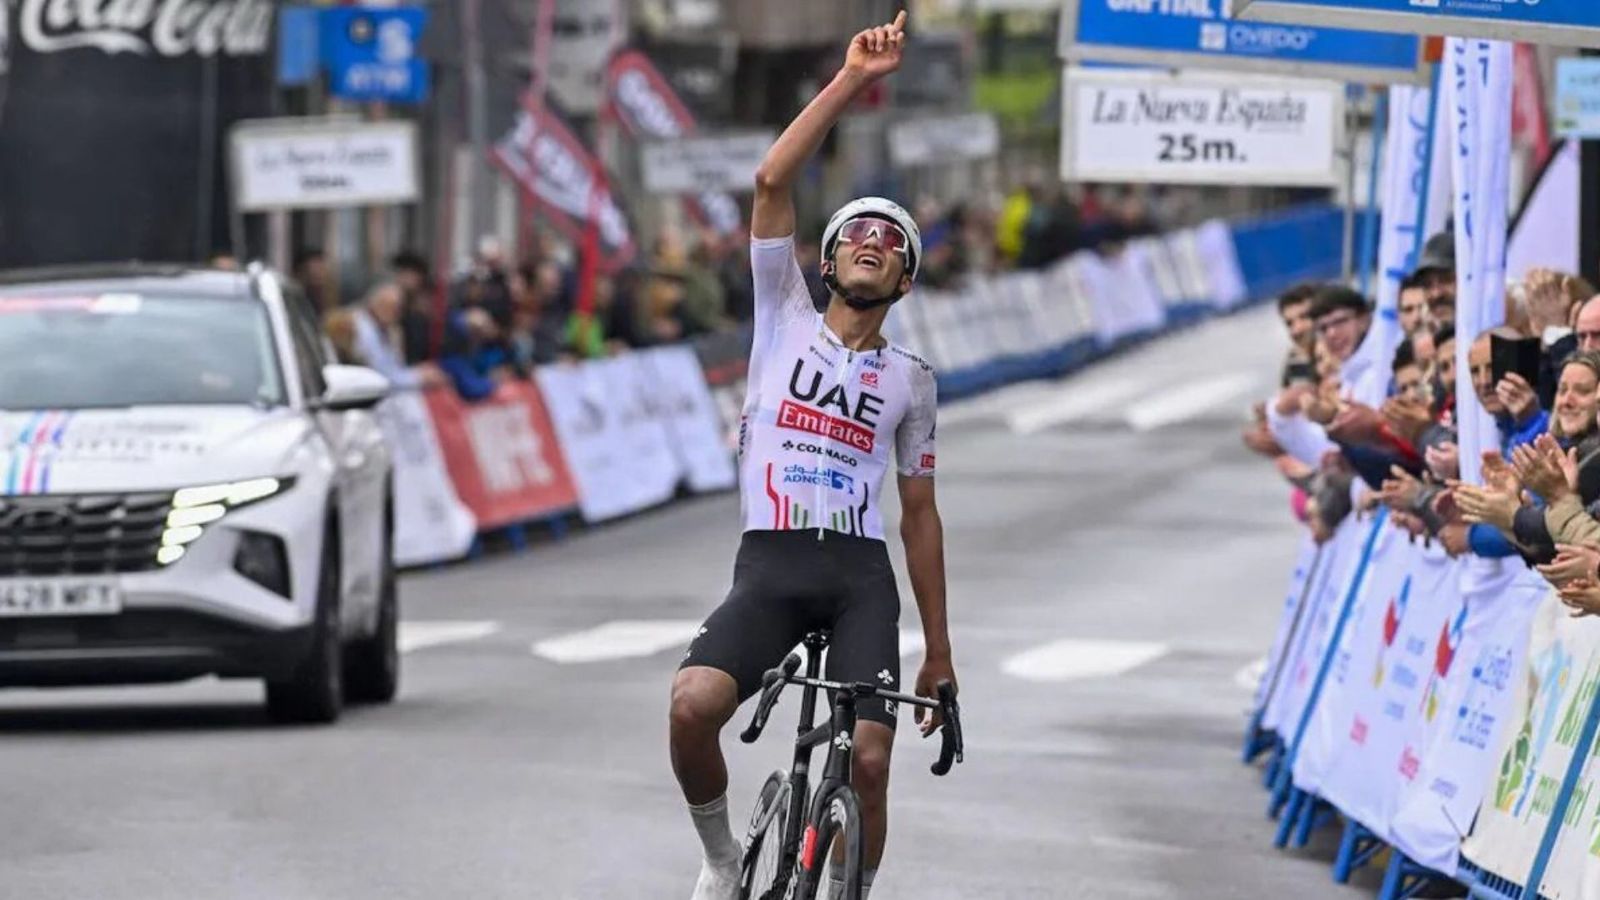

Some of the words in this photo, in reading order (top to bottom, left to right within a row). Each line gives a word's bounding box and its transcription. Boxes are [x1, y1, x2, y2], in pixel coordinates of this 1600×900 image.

[1092, 89, 1127, 124] La
[1132, 89, 1210, 126] Nueva
[1214, 88, 1309, 131] España
[1158, 132, 1248, 163] 25m.
[789, 358, 885, 429] UAE
[780, 402, 874, 452] Emirates
[796, 442, 859, 468] COLNAGO
[783, 473, 831, 488] ADNOC
